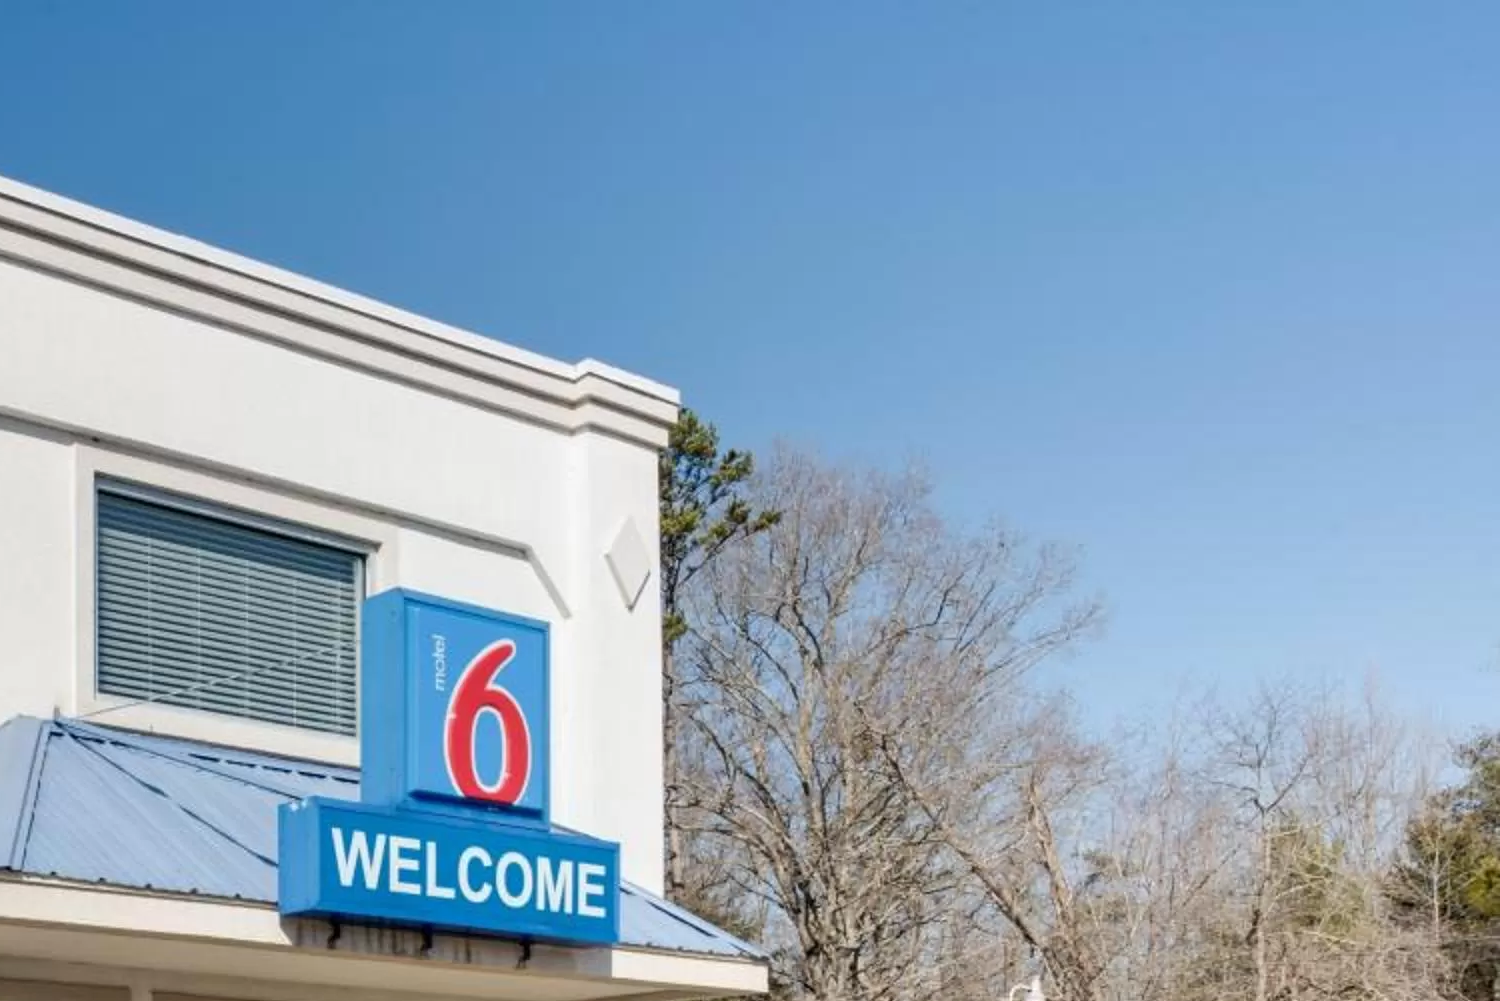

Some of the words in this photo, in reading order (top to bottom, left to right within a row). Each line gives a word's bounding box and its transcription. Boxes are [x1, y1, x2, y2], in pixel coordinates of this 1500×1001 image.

[431, 633, 447, 691] motel
[444, 638, 532, 806] 6
[331, 826, 607, 918] WELCOME
